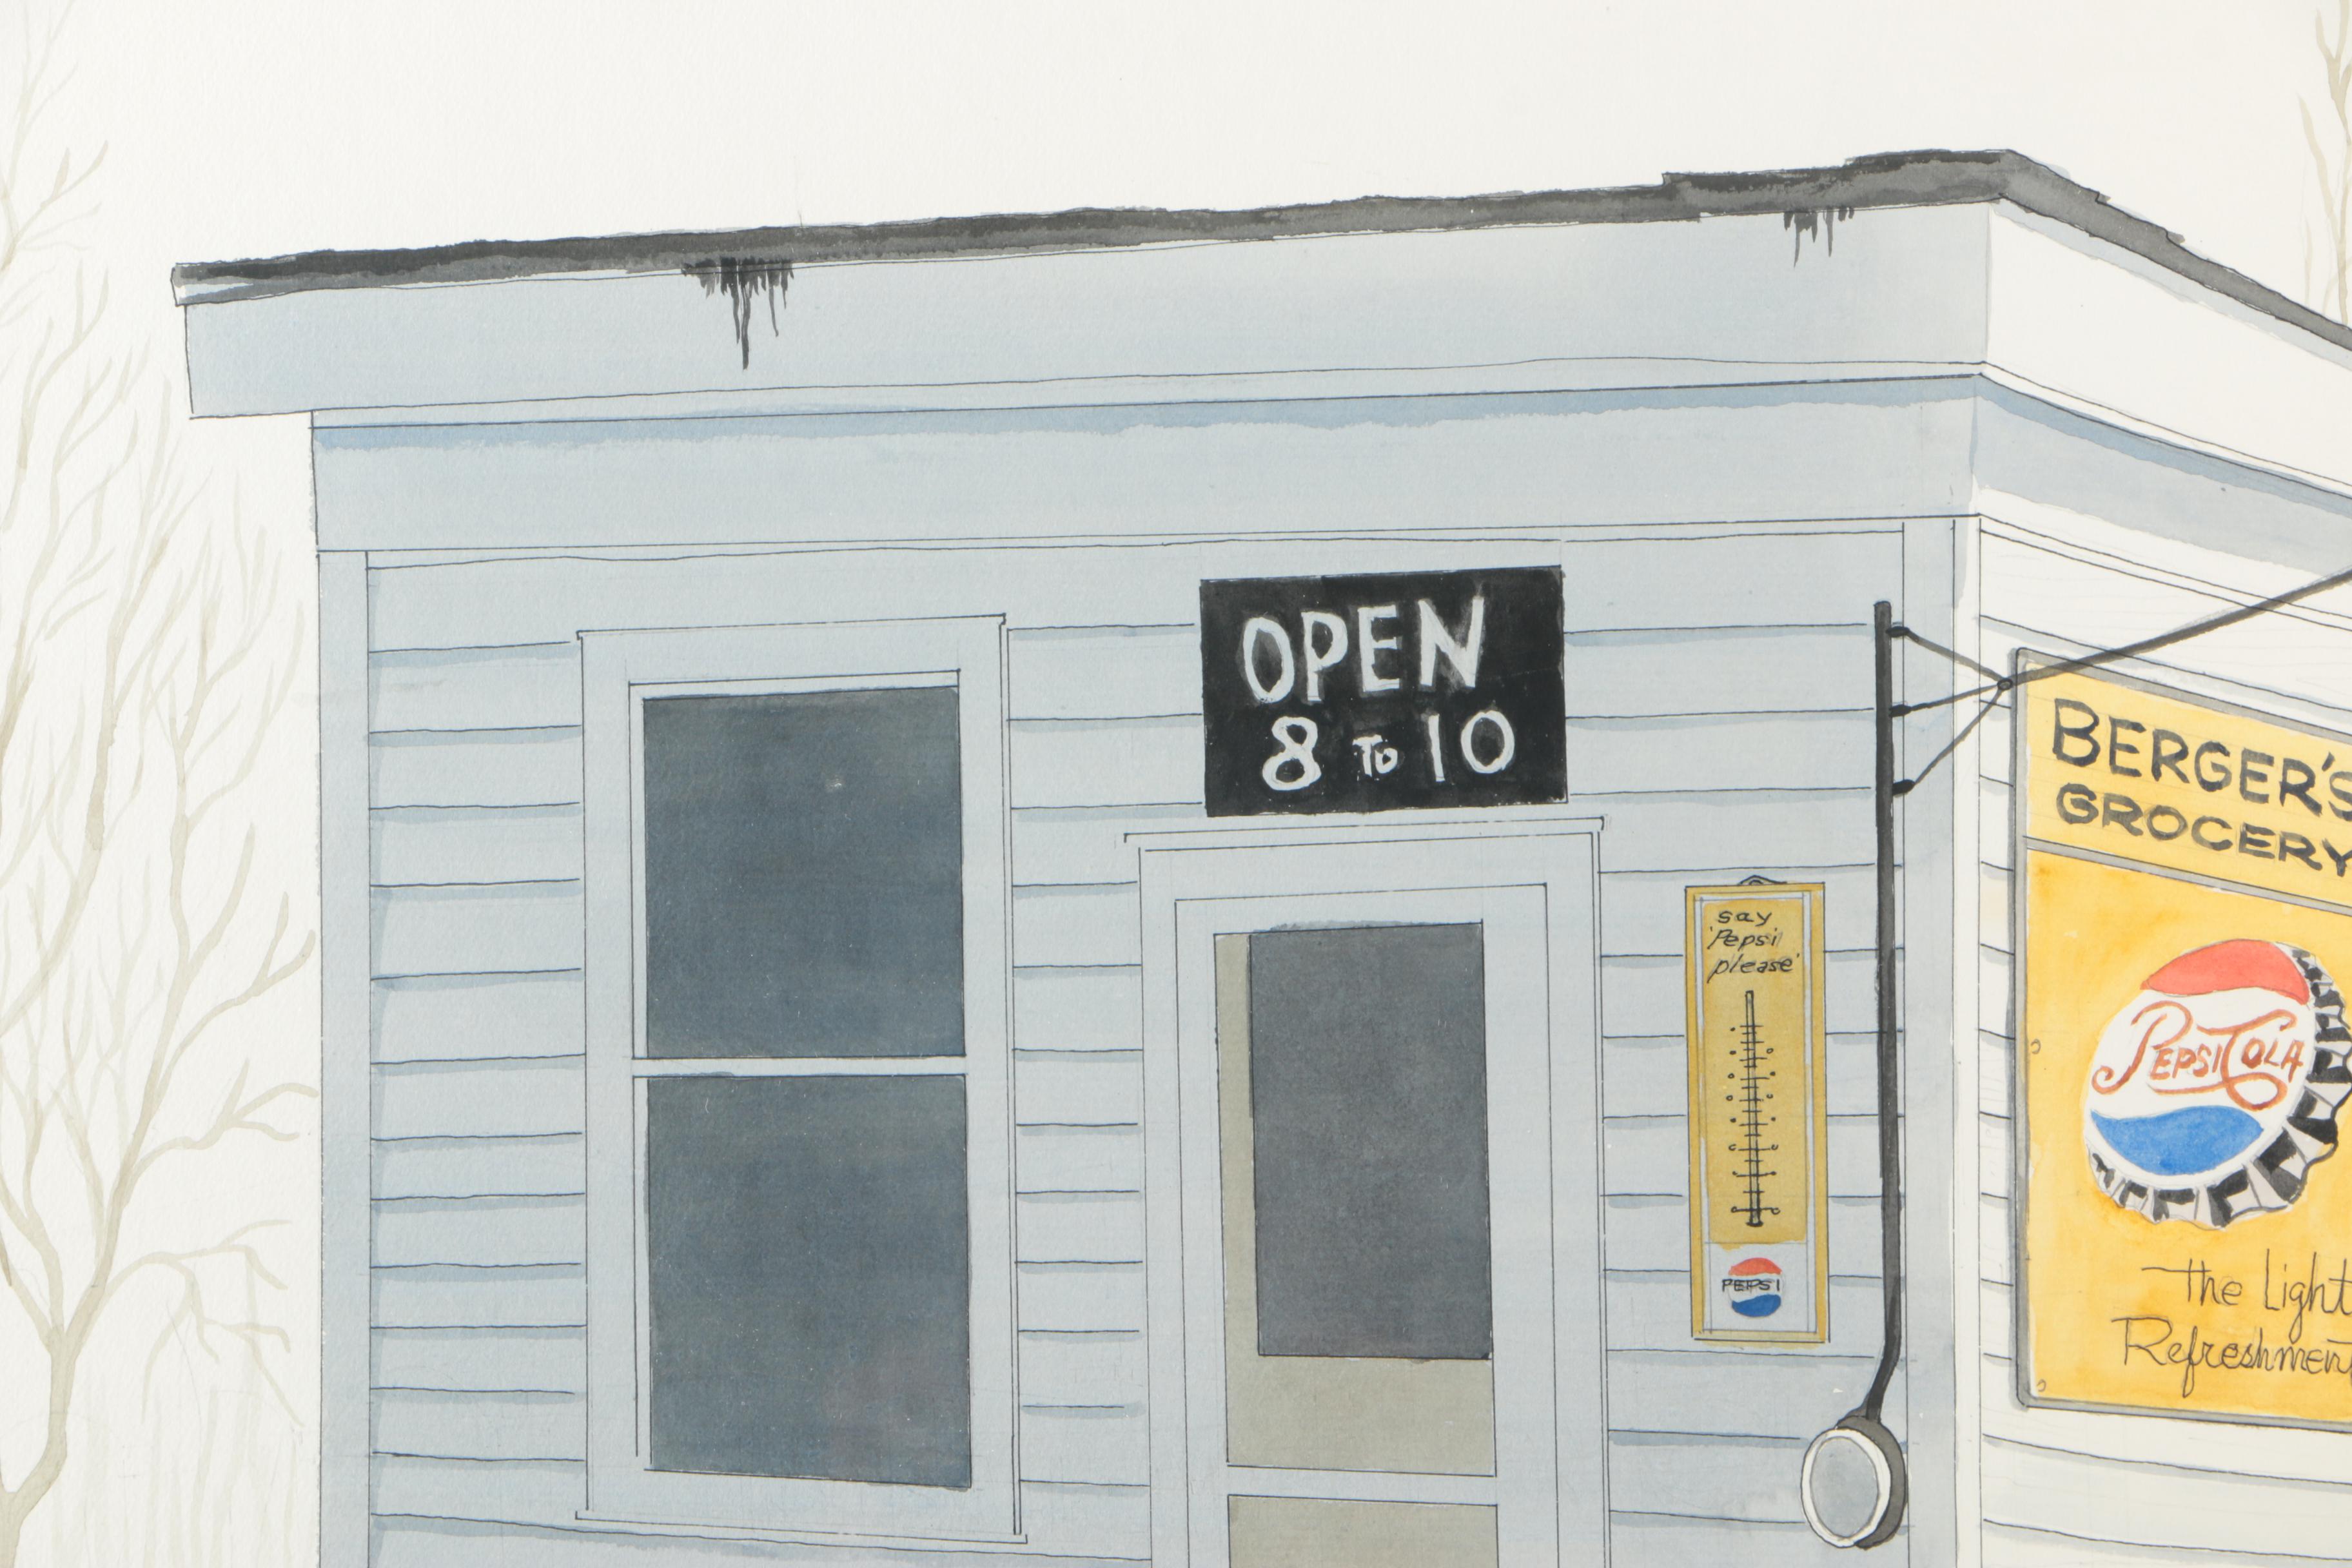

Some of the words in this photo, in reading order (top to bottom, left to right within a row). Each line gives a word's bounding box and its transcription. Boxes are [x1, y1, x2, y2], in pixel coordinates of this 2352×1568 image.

[1242, 595, 1485, 703] OPEN
[1262, 716, 1322, 791] 8
[1427, 710, 1515, 783] 10
[2055, 782, 2352, 877] GROCERY
[1718, 910, 1772, 927] say
[1721, 1278, 1780, 1292] PEPSI
